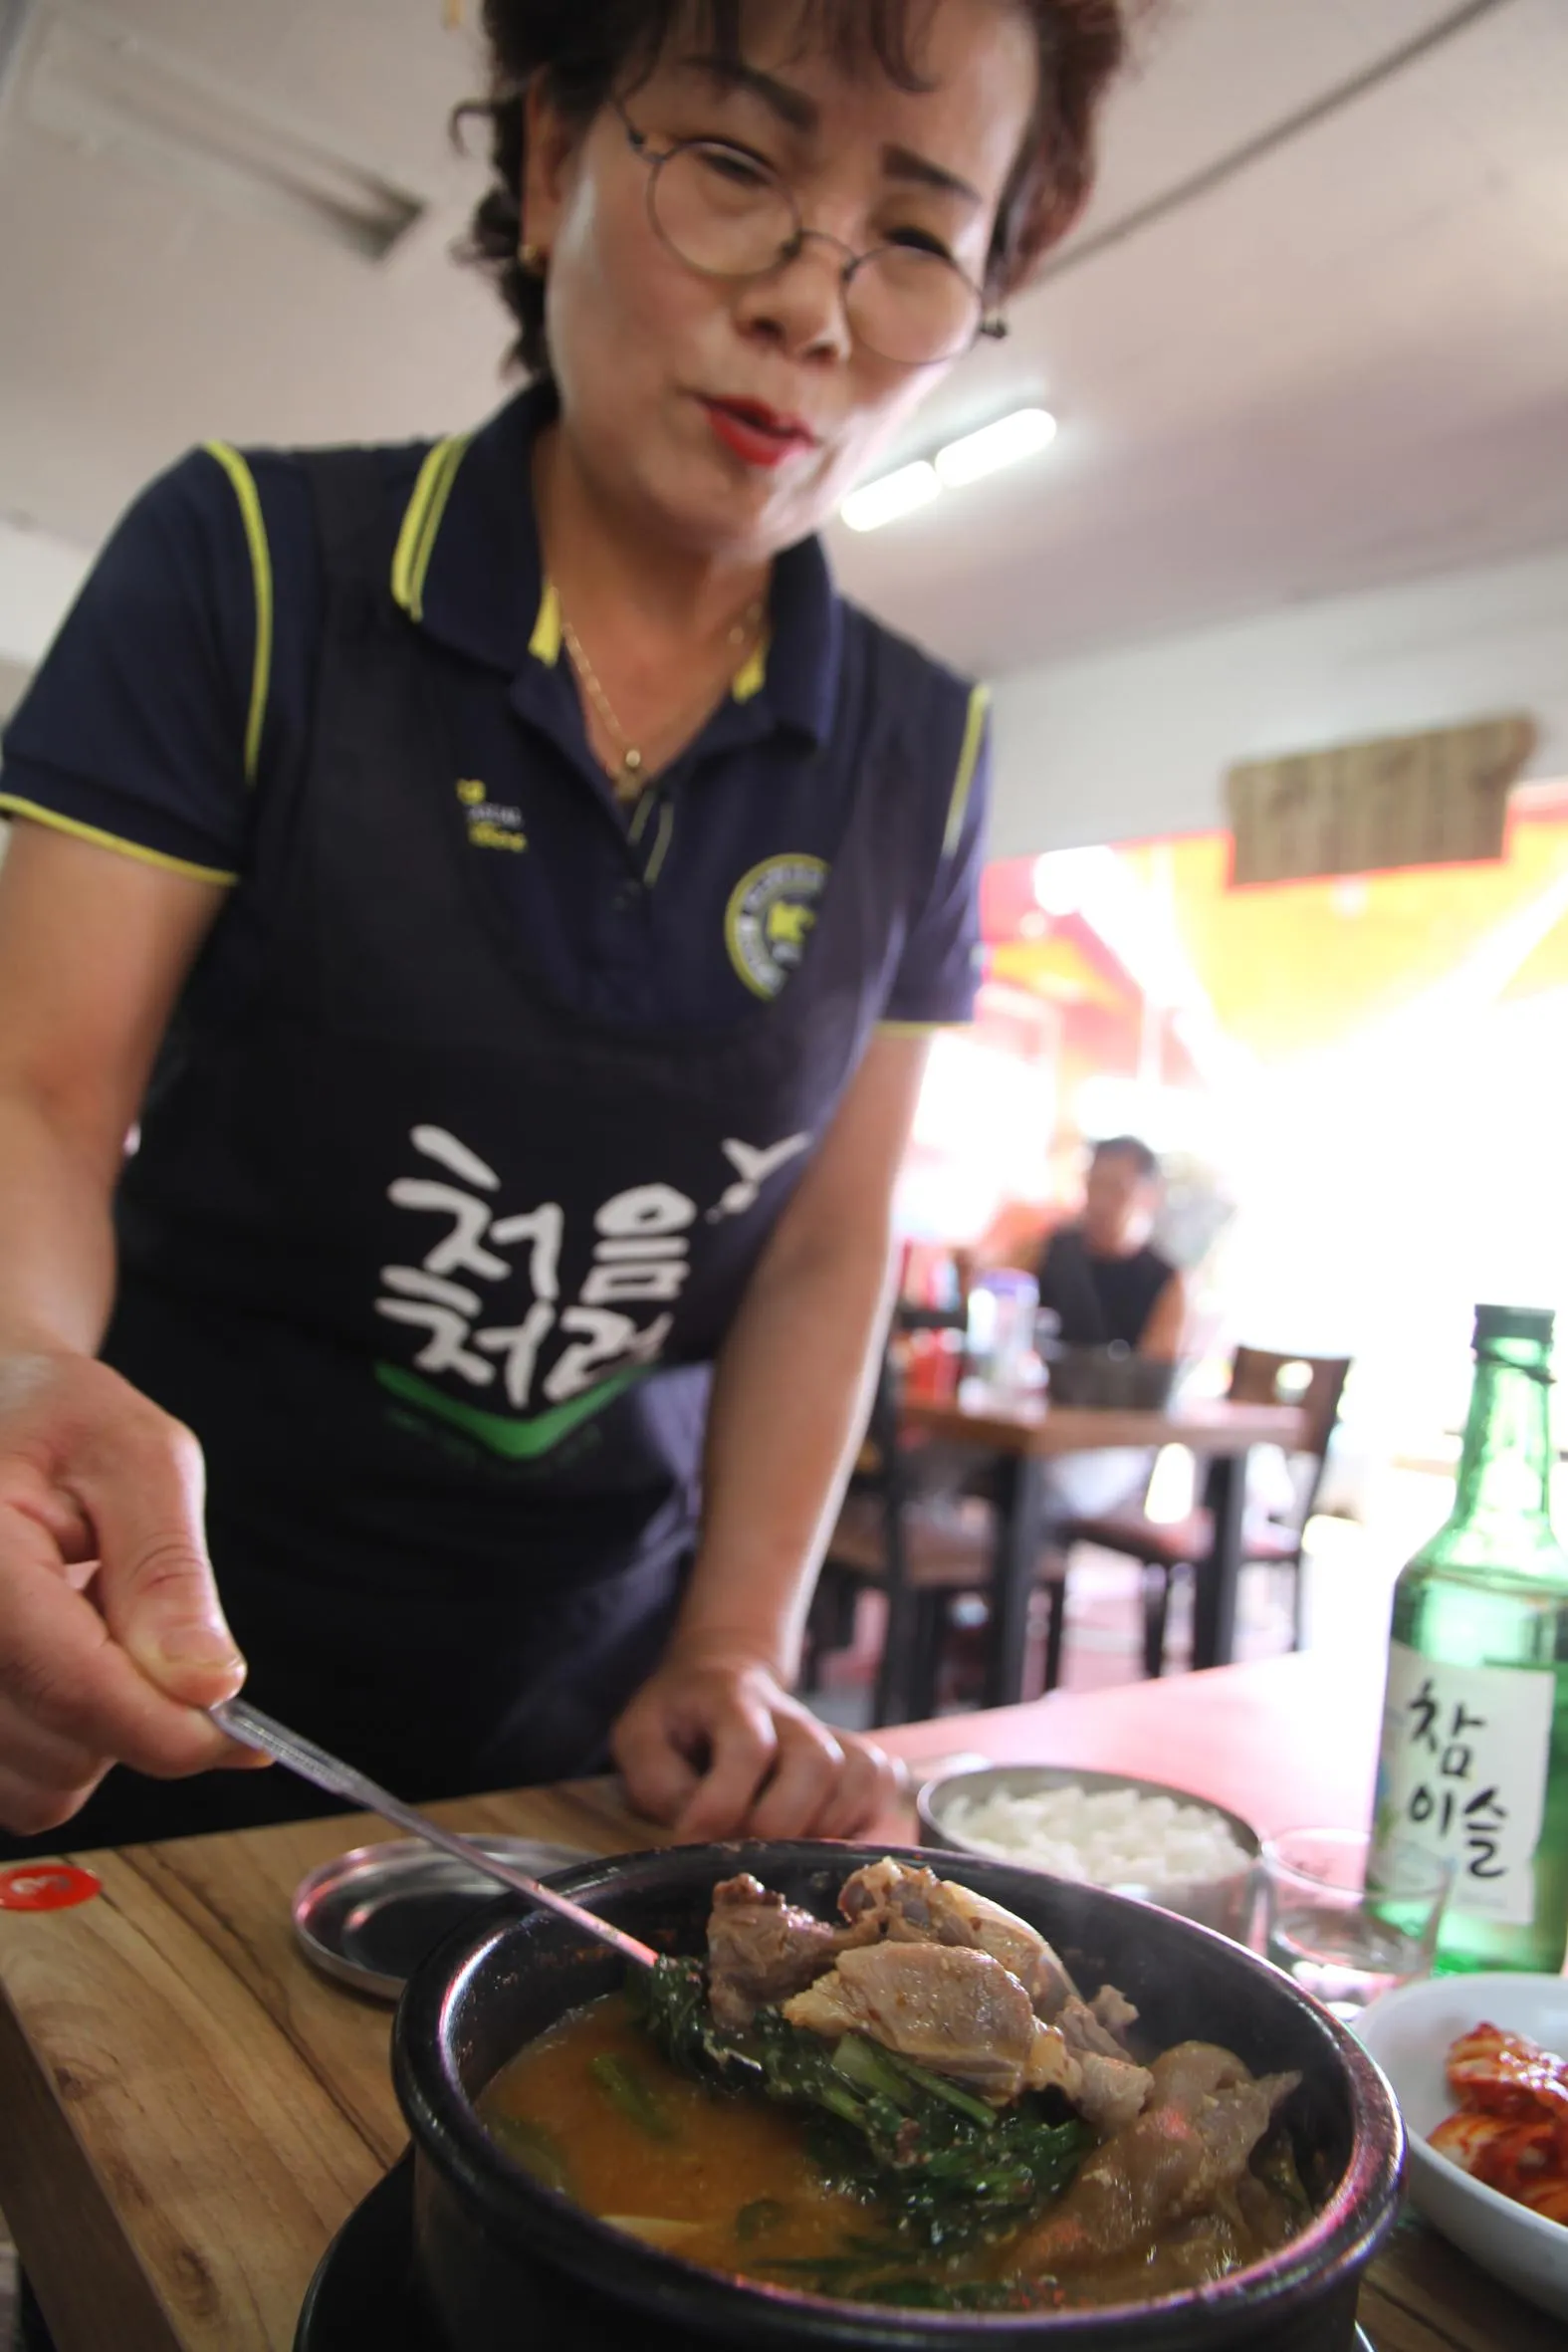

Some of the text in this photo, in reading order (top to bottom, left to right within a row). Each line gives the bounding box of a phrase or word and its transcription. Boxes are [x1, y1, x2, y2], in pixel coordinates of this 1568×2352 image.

[386, 1122, 698, 1305] 처음
[1408, 1676, 1487, 1778] 참
[1408, 1784, 1510, 1879] 이슬
